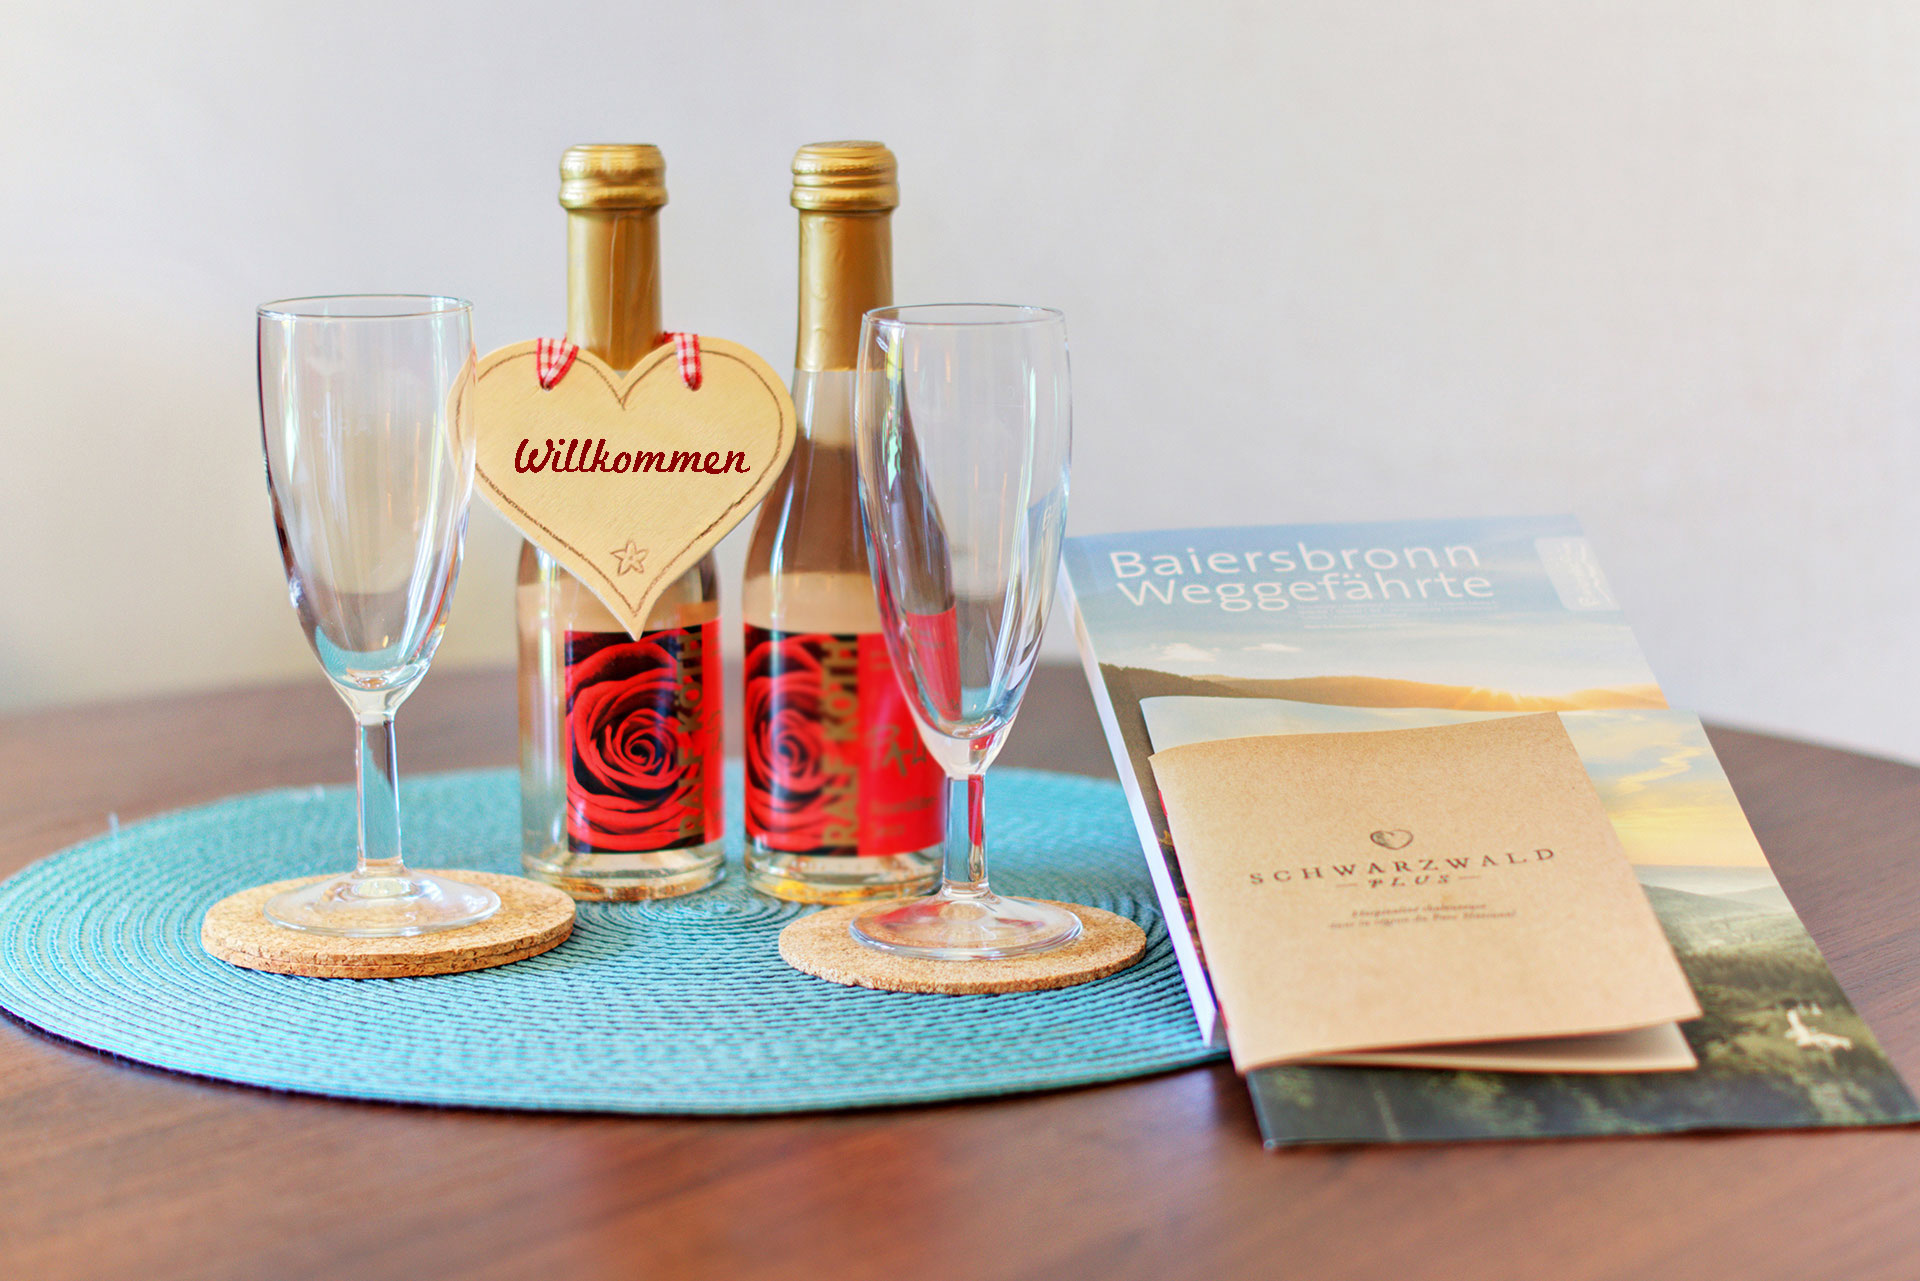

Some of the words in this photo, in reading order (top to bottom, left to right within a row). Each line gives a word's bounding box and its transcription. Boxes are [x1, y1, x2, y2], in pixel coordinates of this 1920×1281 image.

[1109, 542, 1480, 580] Baiersbronn
[1116, 571, 1495, 612] Weggefährte
[1249, 848, 1556, 885] SCHWARZWALD
[1367, 874, 1451, 889] PLUS
